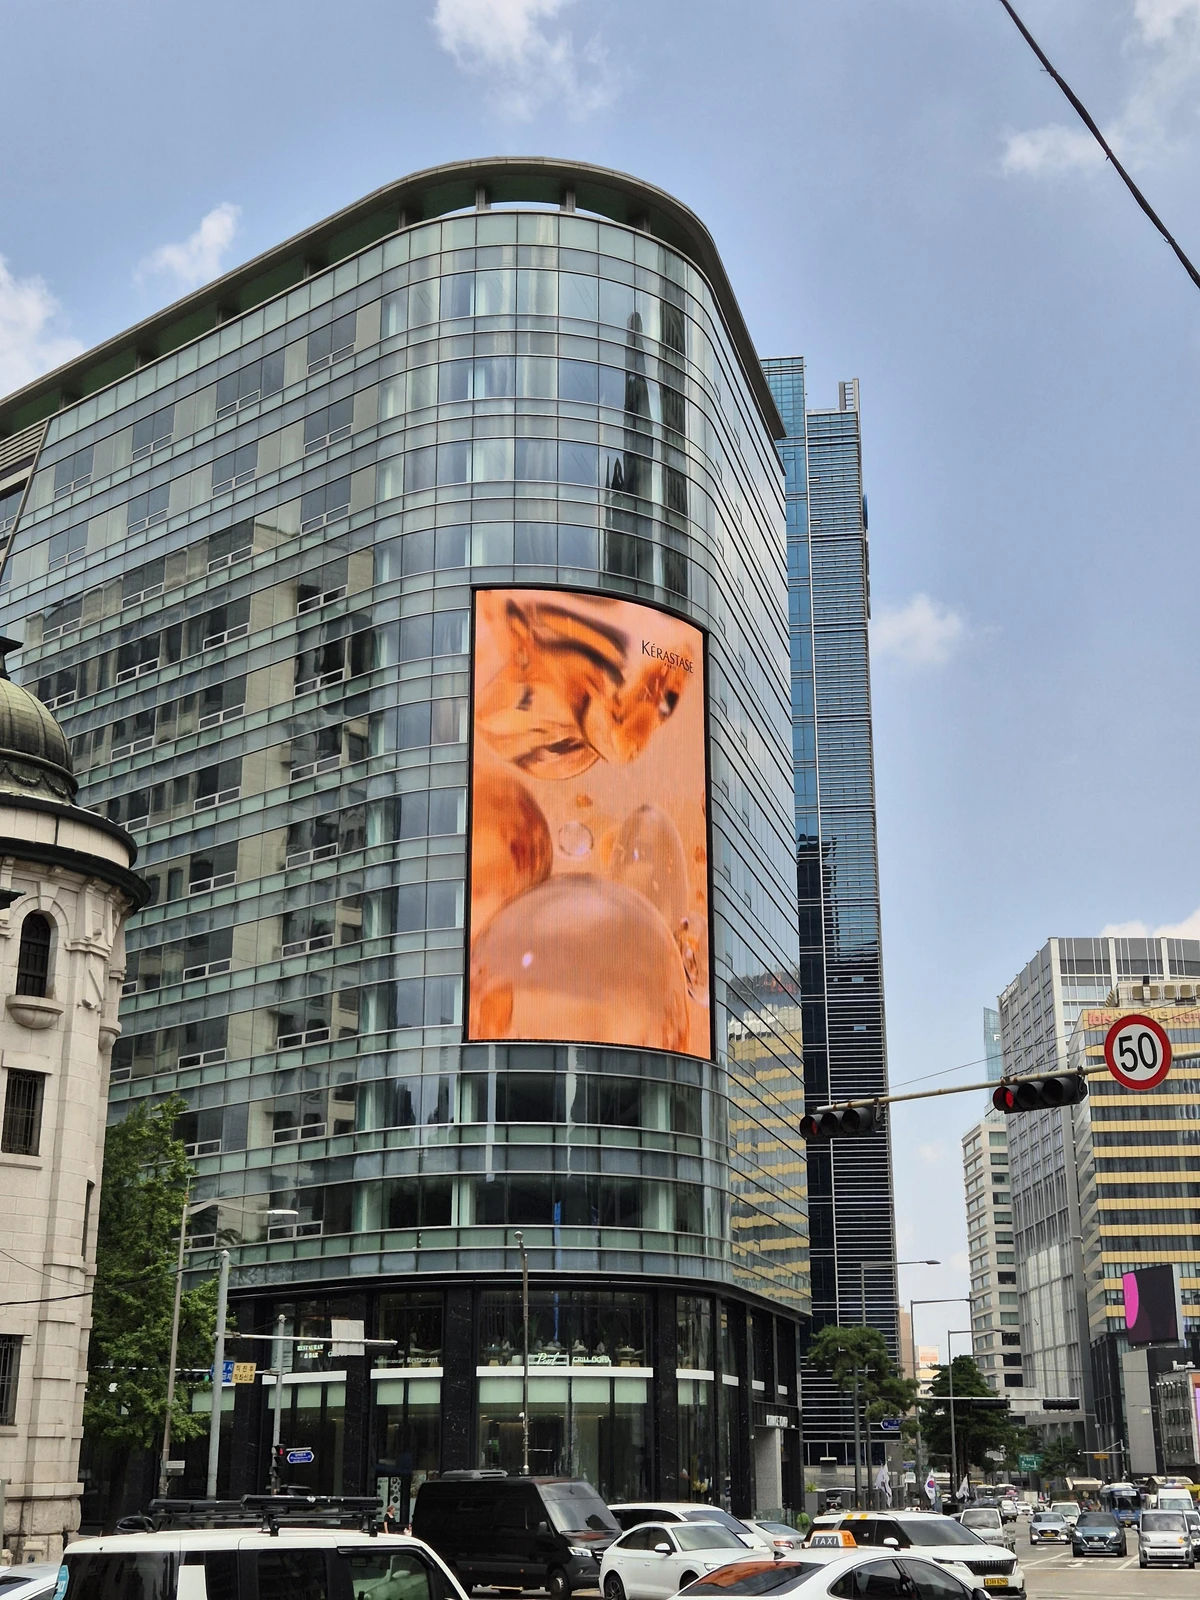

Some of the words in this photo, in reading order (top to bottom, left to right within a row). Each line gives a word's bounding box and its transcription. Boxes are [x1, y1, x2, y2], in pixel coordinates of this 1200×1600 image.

[641, 639, 694, 674] KÉRASTASE
[1088, 1011, 1112, 1026] ibis
[1118, 1031, 1158, 1073] 50
[406, 1356, 439, 1364] Restaurant
[814, 1537, 837, 1546] TAXI
